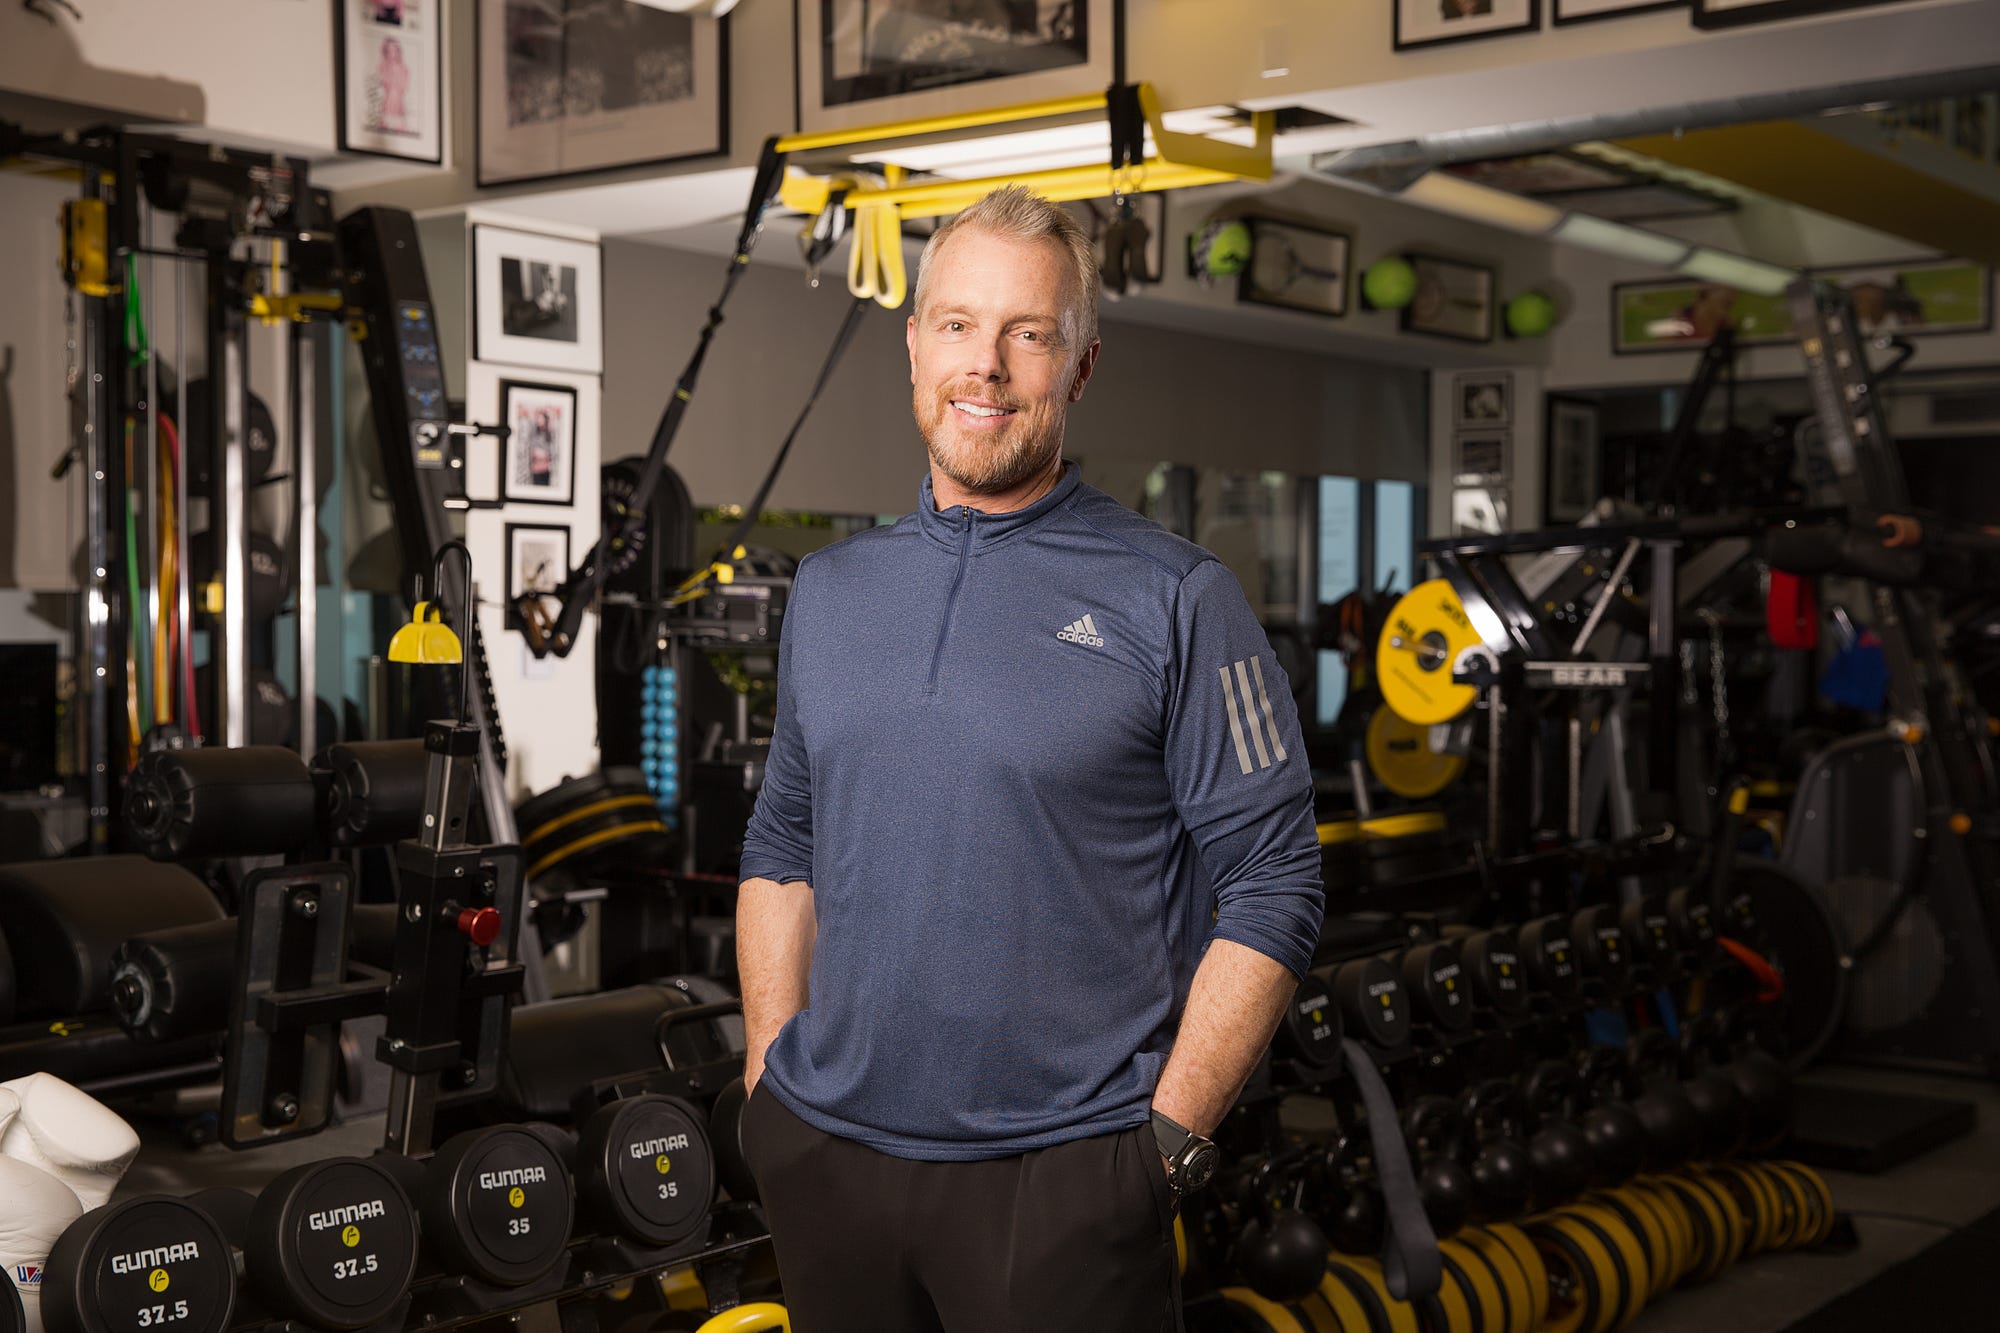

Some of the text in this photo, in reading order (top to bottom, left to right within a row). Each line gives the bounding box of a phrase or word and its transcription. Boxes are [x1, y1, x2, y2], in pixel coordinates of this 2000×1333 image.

[1056, 630, 1104, 647] adidas
[630, 1134, 689, 1158] GUNNAR
[480, 1166, 546, 1189] GUNNAR
[658, 1182, 678, 1199] 35
[309, 1200, 385, 1231] GUNNAR
[509, 1218, 530, 1235] 35
[111, 1241, 199, 1274] GUNNAR
[333, 1254, 378, 1279] 37.5
[137, 1300, 189, 1327] 37.5
